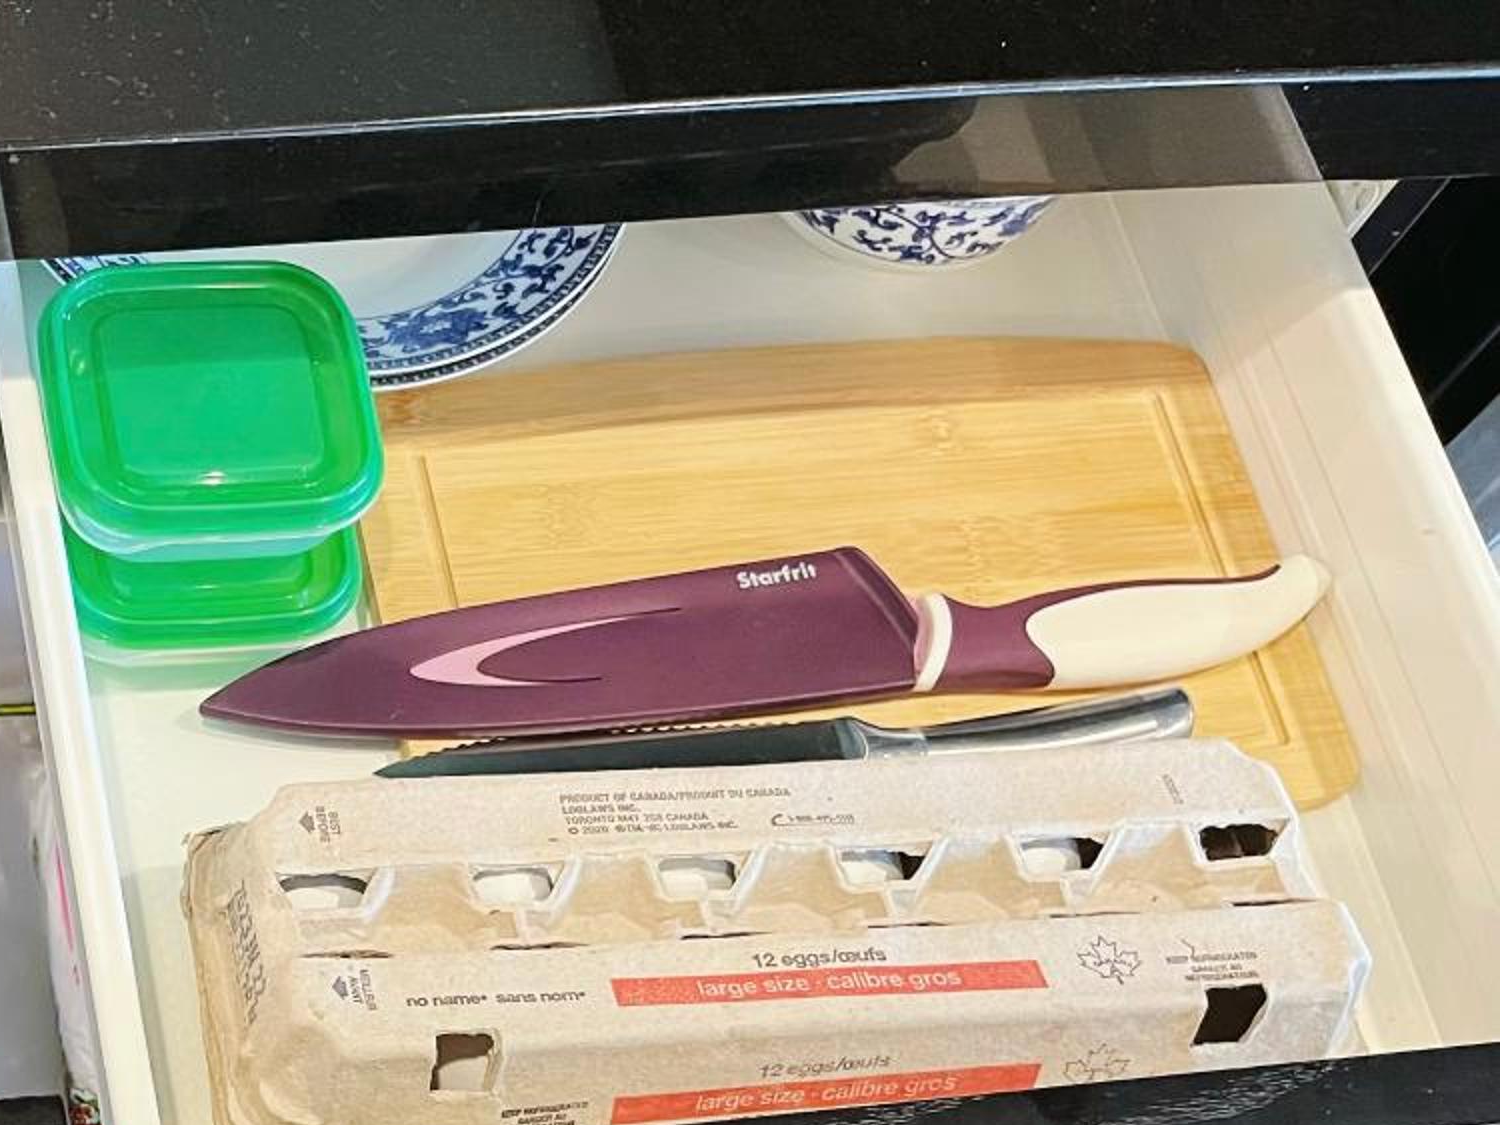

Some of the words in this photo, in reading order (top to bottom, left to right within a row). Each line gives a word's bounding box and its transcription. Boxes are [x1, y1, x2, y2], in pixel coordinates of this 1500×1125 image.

[736, 562, 817, 589] Starfrit
[752, 952, 778, 968] 12
[697, 979, 757, 999] large
[765, 976, 809, 993] size
[828, 971, 902, 990] calibre
[910, 969, 963, 988] gros
[407, 997, 429, 1007] no
[495, 993, 538, 1004] sans
[759, 1063, 785, 1078] 12
[695, 1093, 755, 1113] large
[759, 1086, 806, 1105] size
[822, 1079, 898, 1099] calibre
[903, 1074, 958, 1096] gros
